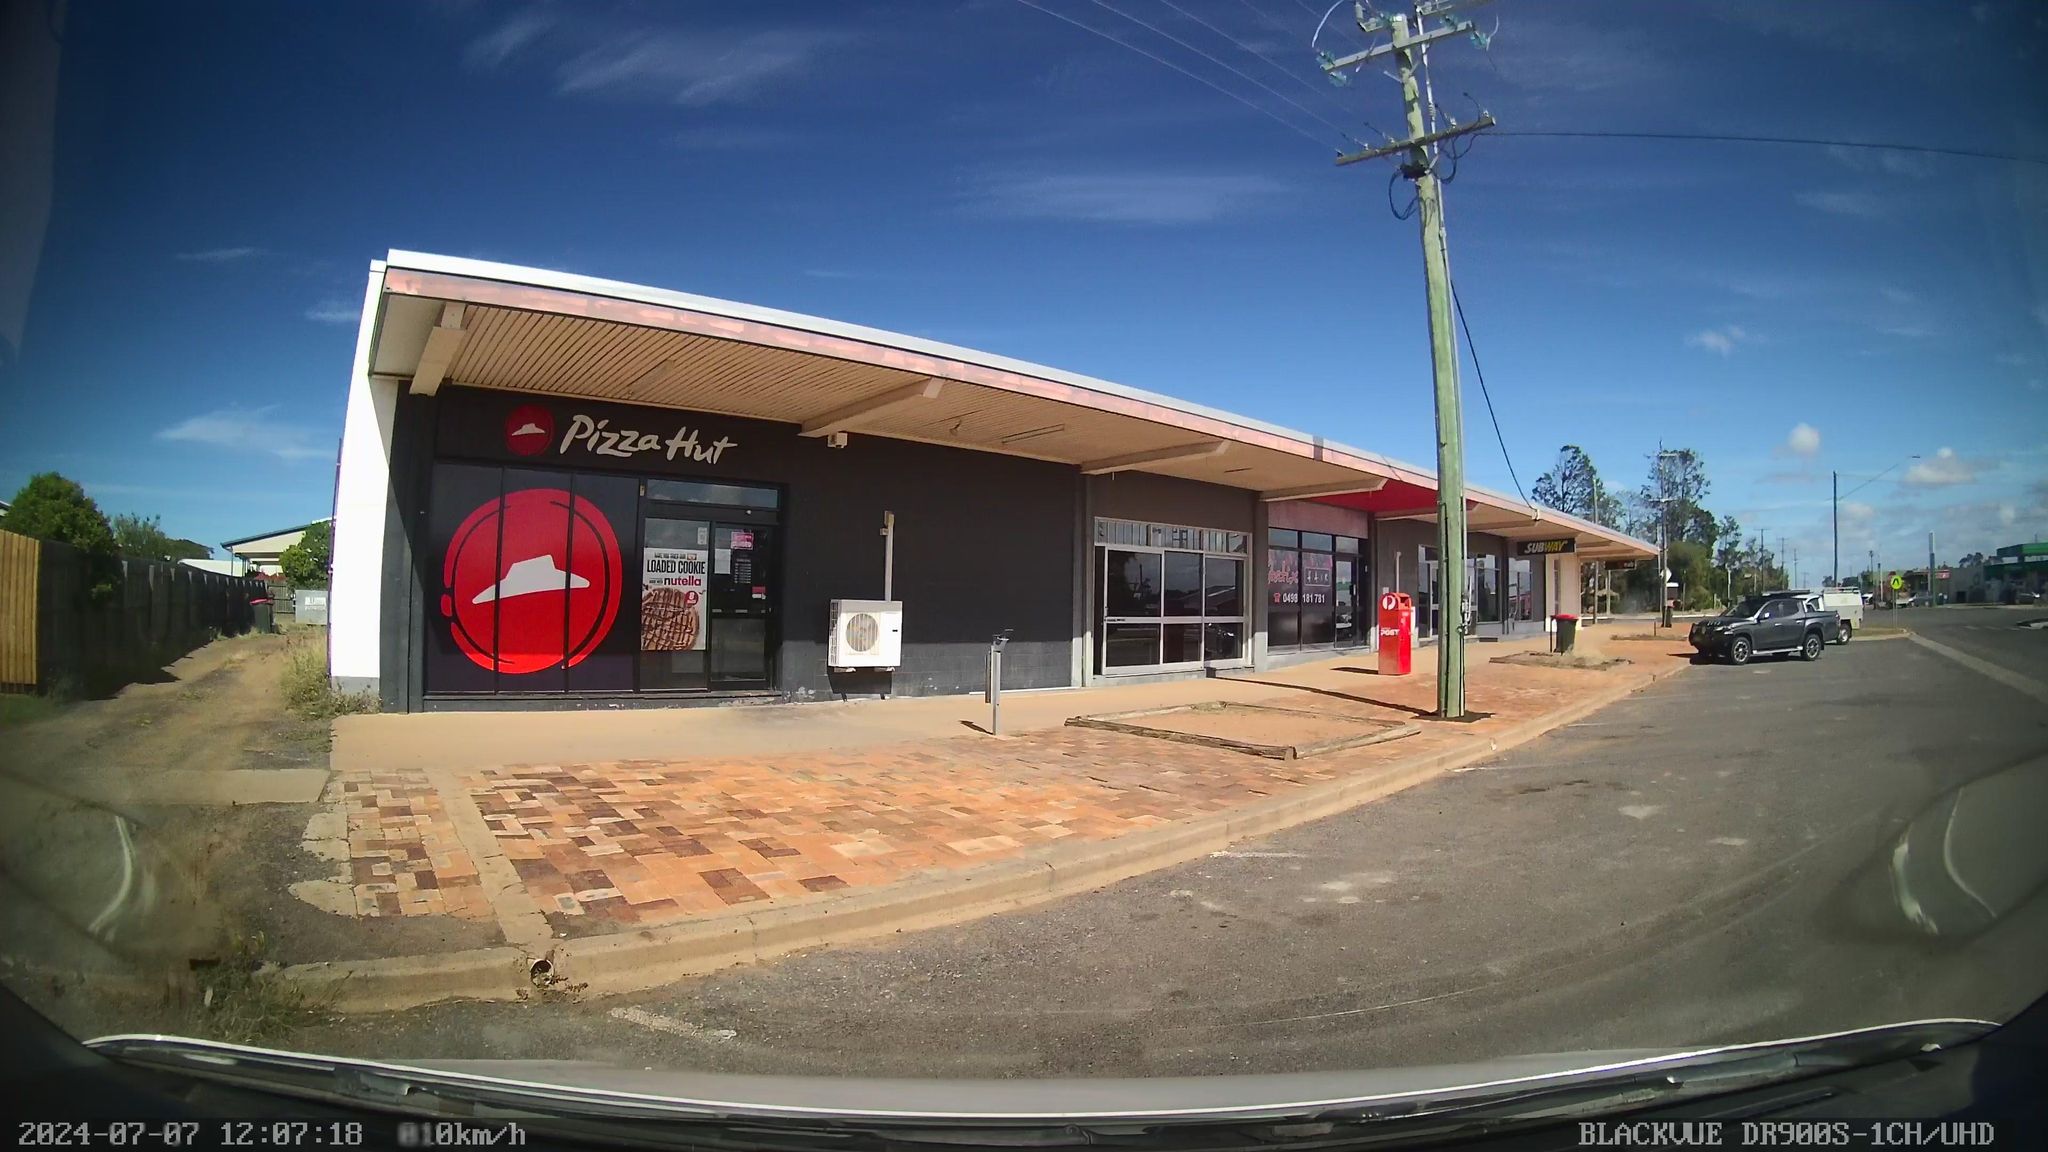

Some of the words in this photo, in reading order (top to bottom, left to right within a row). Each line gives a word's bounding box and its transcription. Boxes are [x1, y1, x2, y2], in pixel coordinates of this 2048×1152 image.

[559, 414, 661, 458] Pizza
[665, 426, 738, 464] Hut
[1524, 540, 1568, 554] SUBWAY
[647, 559, 676, 573] LOADED
[678, 560, 706, 575] COOKIE
[664, 575, 701, 586] nutella
[1380, 628, 1400, 637] POST
